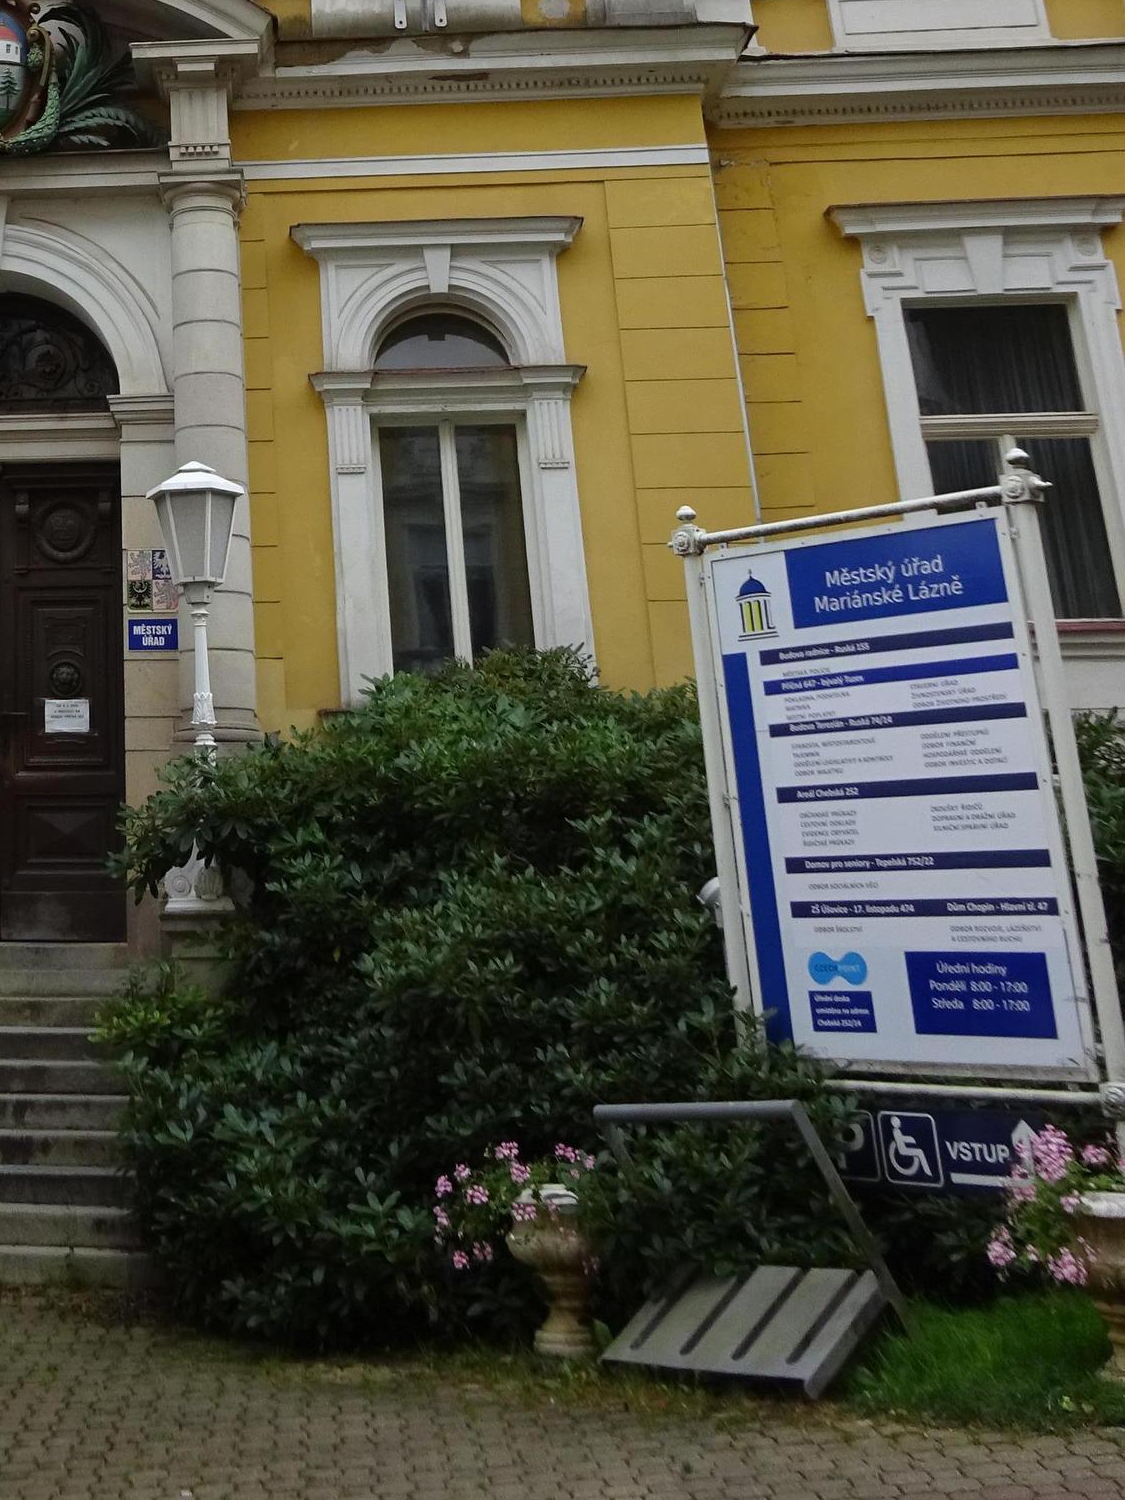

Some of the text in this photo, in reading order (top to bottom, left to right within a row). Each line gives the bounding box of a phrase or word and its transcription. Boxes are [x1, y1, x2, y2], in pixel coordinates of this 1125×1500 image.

[826, 554, 944, 587] Městský úřad
[814, 575, 963, 613] Mariánské Lázně
[133, 624, 172, 635] MĚSTSKÝ
[142, 635, 165, 646] ÚŘAD
[804, 860, 830, 869] Domov
[831, 861, 843, 870] pro
[844, 859, 870, 869] seniory
[936, 960, 1007, 976] Úřední hodiny
[929, 980, 967, 992] Pondělí
[970, 980, 993, 992] 8:00
[999, 981, 1028, 993] 17:00
[932, 998, 964, 1010] Středa
[972, 998, 995, 1010] 8:00
[1002, 999, 1031, 1012] 17:00
[945, 1141, 1010, 1163] VSTUP
